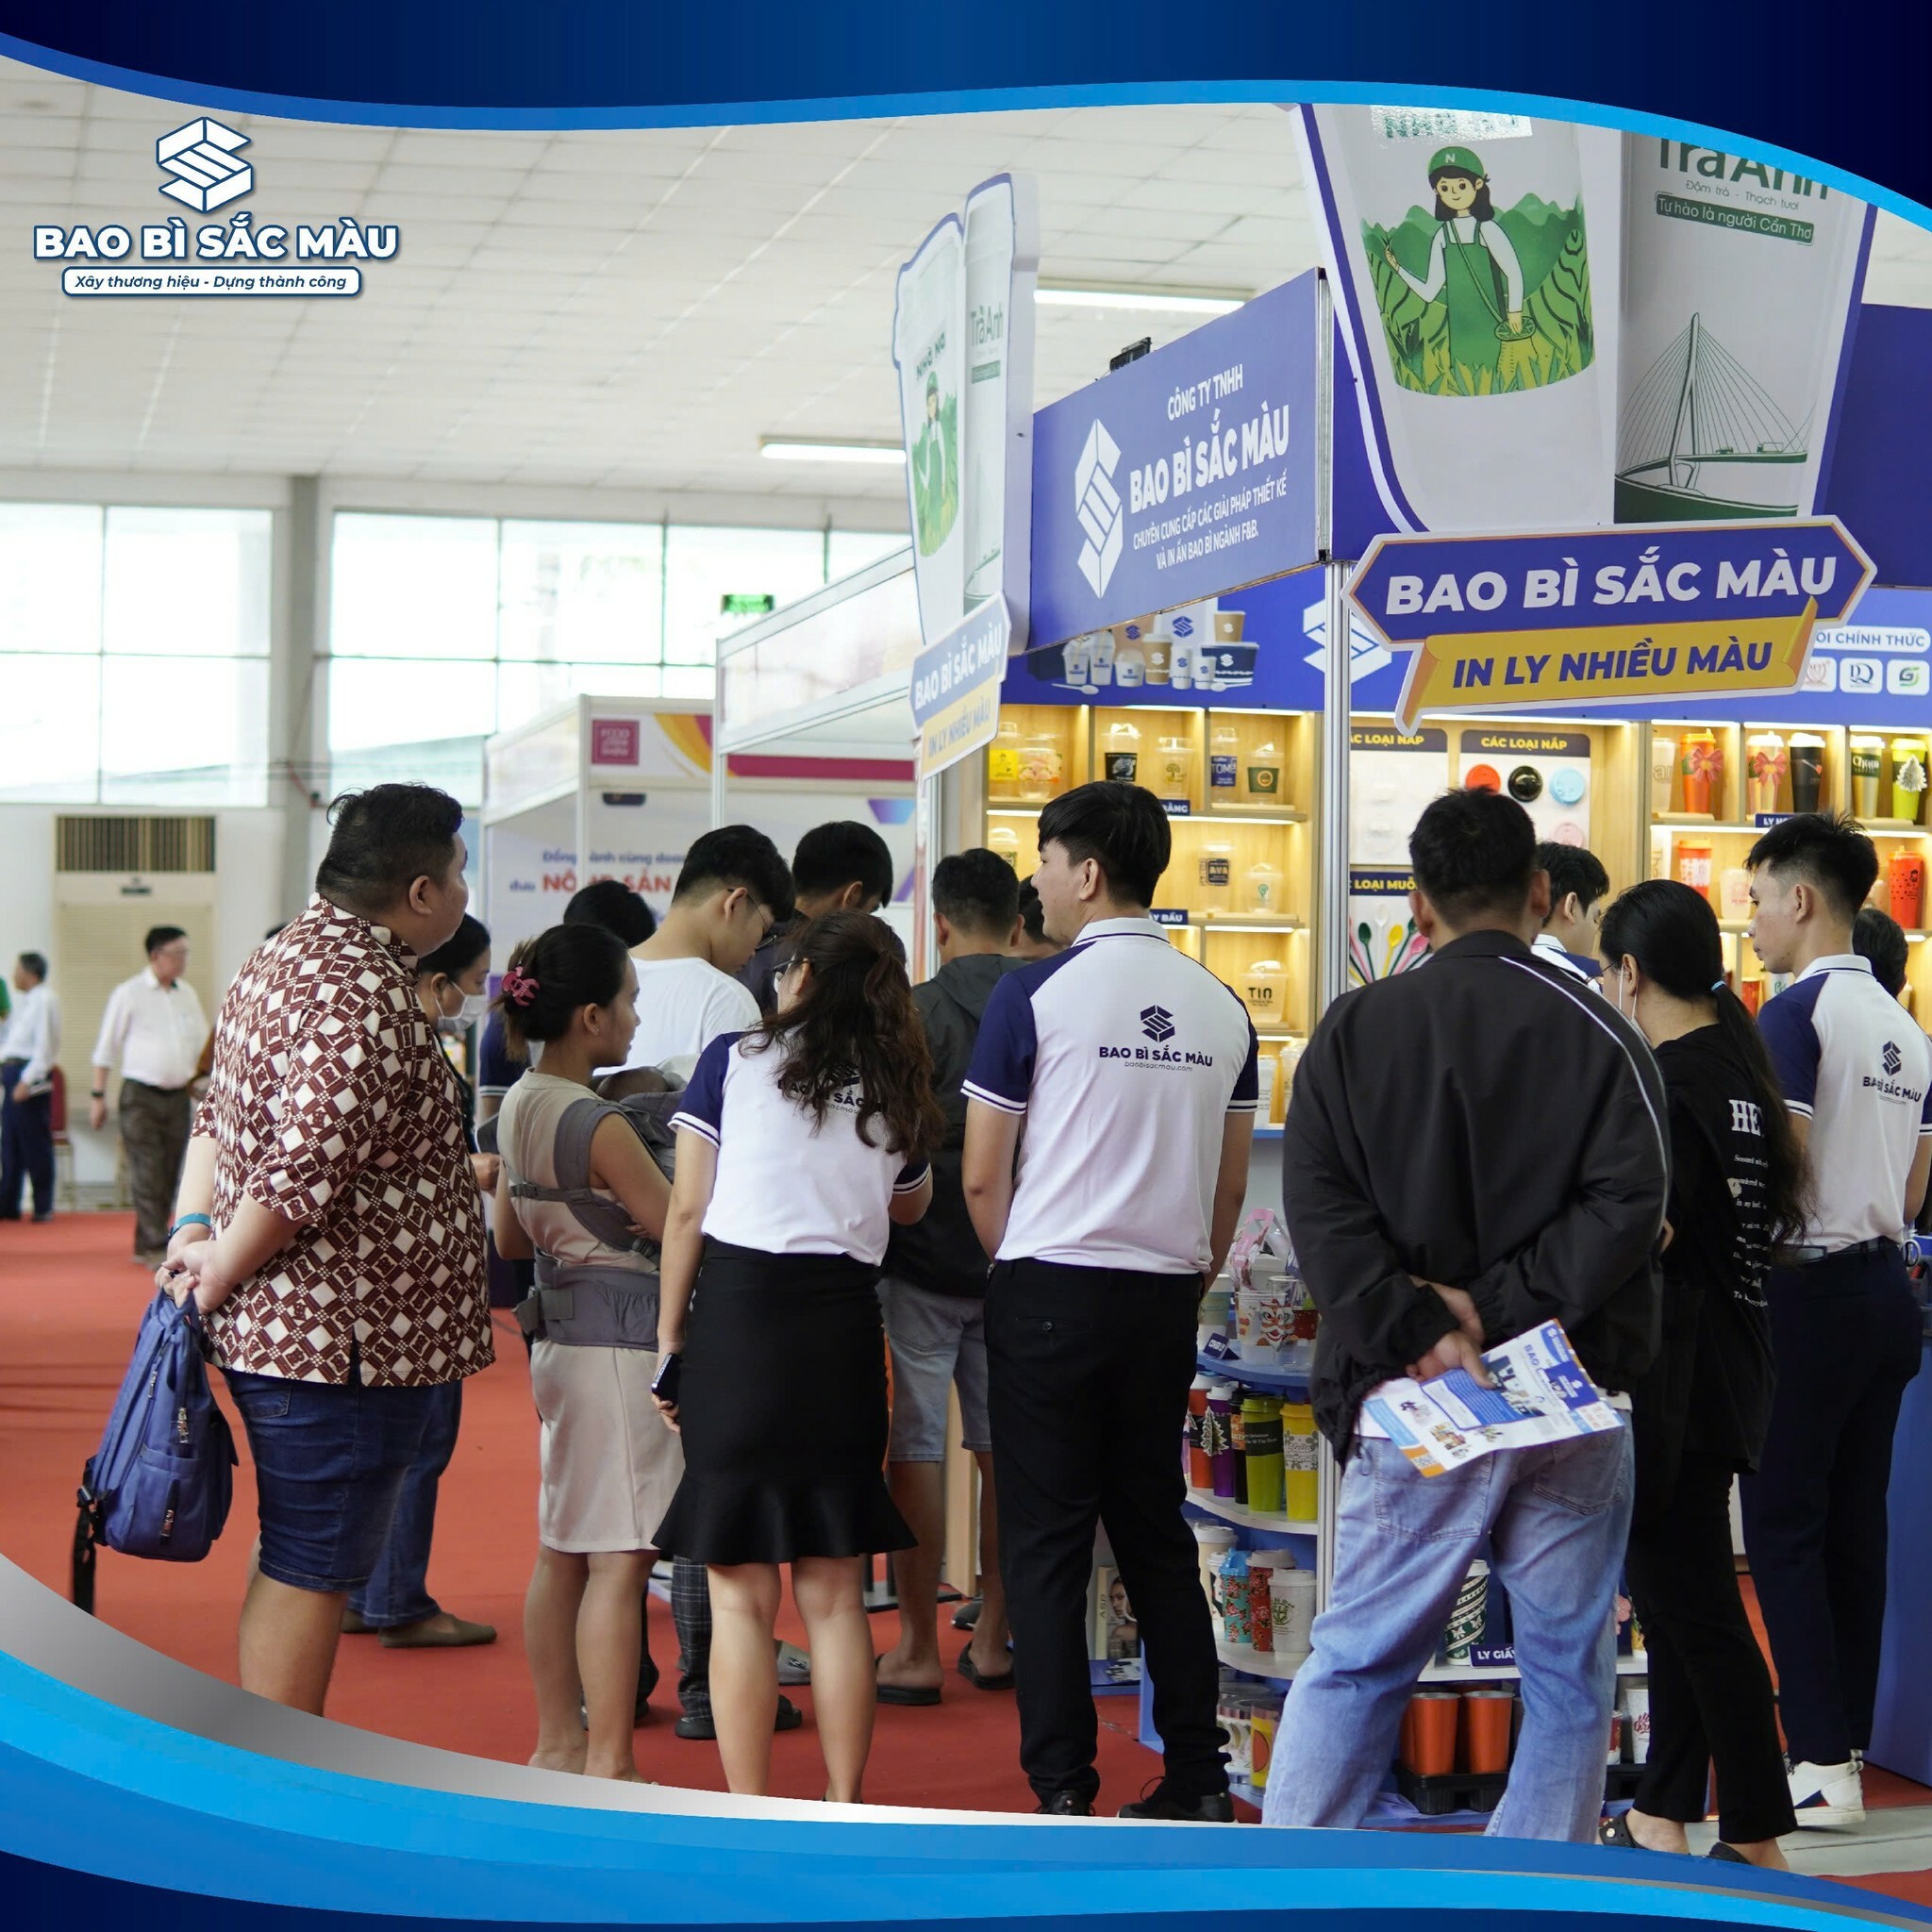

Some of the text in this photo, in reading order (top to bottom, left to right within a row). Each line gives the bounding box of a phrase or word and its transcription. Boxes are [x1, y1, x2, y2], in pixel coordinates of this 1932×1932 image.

[1445, 154, 1456, 163] N
[1658, 198, 1812, 240] Tự hào là người Cần Thơ
[1167, 363, 1243, 421] CÔNG TY TNHH
[1130, 400, 1290, 514] BAO BÌ SẮC MÀU
[1133, 527, 1159, 550] CHUYÊN
[1160, 518, 1180, 541] CUNG
[1182, 504, 1196, 534] CẤP
[1197, 502, 1212, 528] CÁC
[1230, 491, 1251, 516] PHÁP
[1252, 478, 1275, 508] THIẾT
[1276, 467, 1288, 498] KẾ
[1156, 546, 1167, 570] VÀ
[1167, 546, 1175, 567] IN
[1188, 540, 1203, 560] BAO
[1204, 529, 1213, 556] BÌ
[1213, 524, 1240, 553] NGÀNH
[1386, 545, 1838, 616] BAO BÌ SẮC MÀU
[1836, 629, 1882, 645] CHÍNH
[1886, 631, 1926, 647] THỨC
[915, 622, 1003, 711] BAO BÌ SẮC MÀU
[1453, 658, 1494, 690] IN
[1505, 654, 1550, 685] LY
[1559, 636, 1677, 682] NHIỀU
[1687, 636, 1774, 674] MÀU
[1365, 735, 1394, 747] LOẠI
[1481, 736, 1567, 751] CÁC LOẠI NẮP
[1355, 879, 1384, 892] LOẠI
[1099, 1044, 1213, 1067] BAO BÌ SẮC MÀU
[1477, 1650, 1491, 1660] LY
